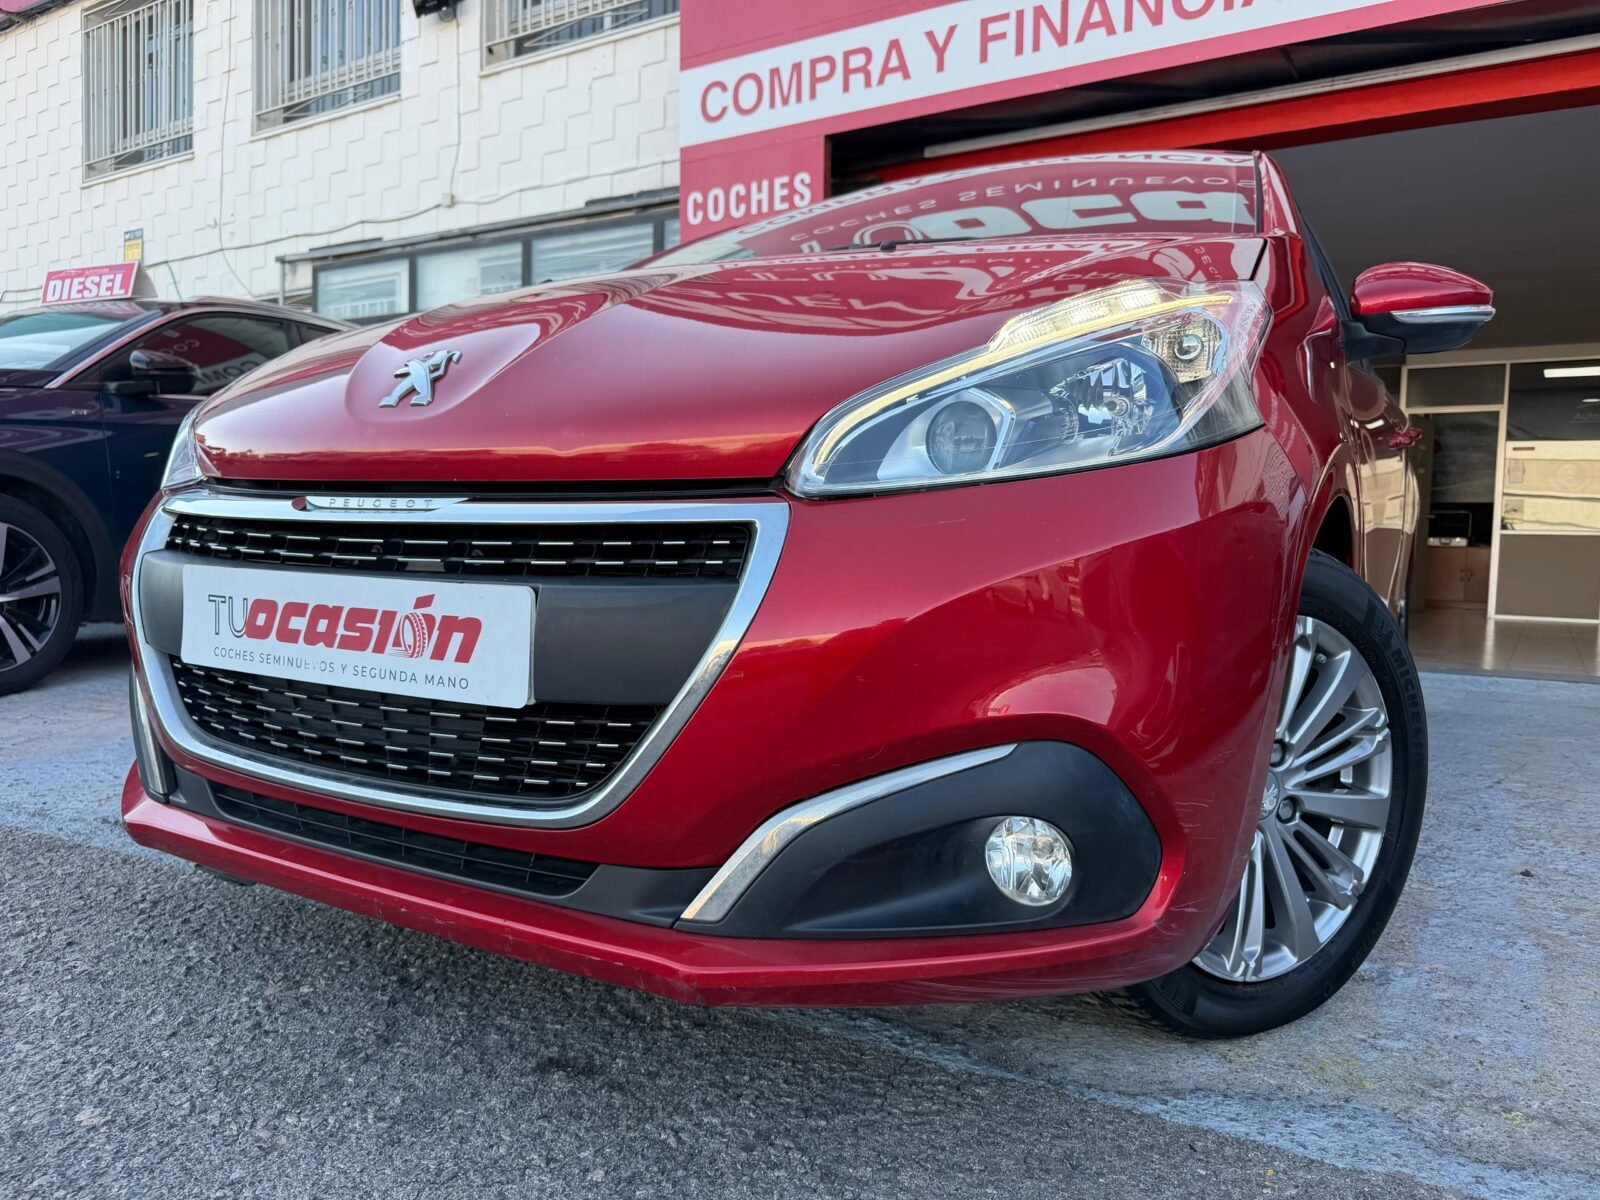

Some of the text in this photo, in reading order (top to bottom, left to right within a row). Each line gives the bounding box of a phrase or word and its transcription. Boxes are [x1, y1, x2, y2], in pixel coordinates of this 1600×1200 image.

[700, 0, 1260, 124] COMPRA Y FINAN
[686, 171, 812, 225] COCHES
[46, 273, 125, 302] DIESEL
[329, 498, 433, 508] PEUGEOT
[213, 646, 255, 662] COCHES
[340, 663, 348, 675] Y
[353, 665, 418, 684] SEGUNDA
[424, 674, 469, 690] MANO
